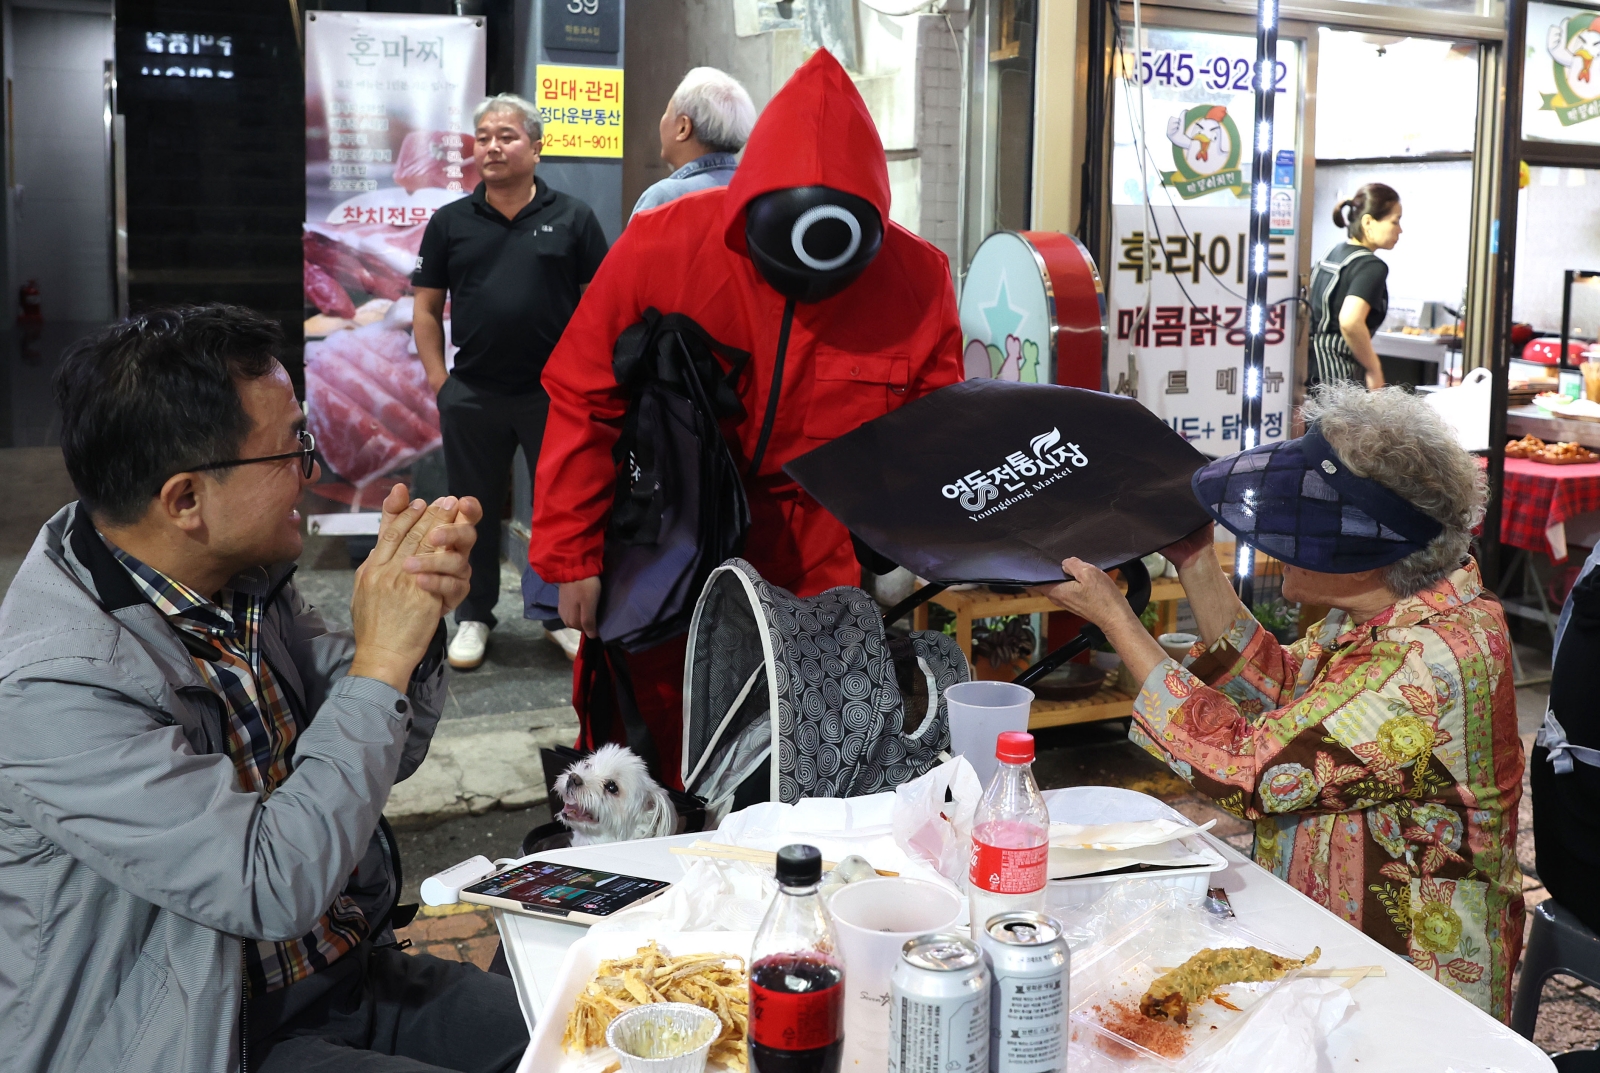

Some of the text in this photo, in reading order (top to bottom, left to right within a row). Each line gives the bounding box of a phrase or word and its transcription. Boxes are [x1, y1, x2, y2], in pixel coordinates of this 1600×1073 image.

[347, 33, 444, 69] 혼마찌
[542, 78, 620, 103] 임대·관리
[540, 107, 621, 126] 정다운부동산
[343, 206, 437, 226] 참치전문
[1118, 231, 1288, 284] 후라이드
[1117, 305, 1286, 347] 매콤닭강정
[941, 440, 1089, 512] 영동전통시장
[968, 466, 1073, 523] Youngdong Market
